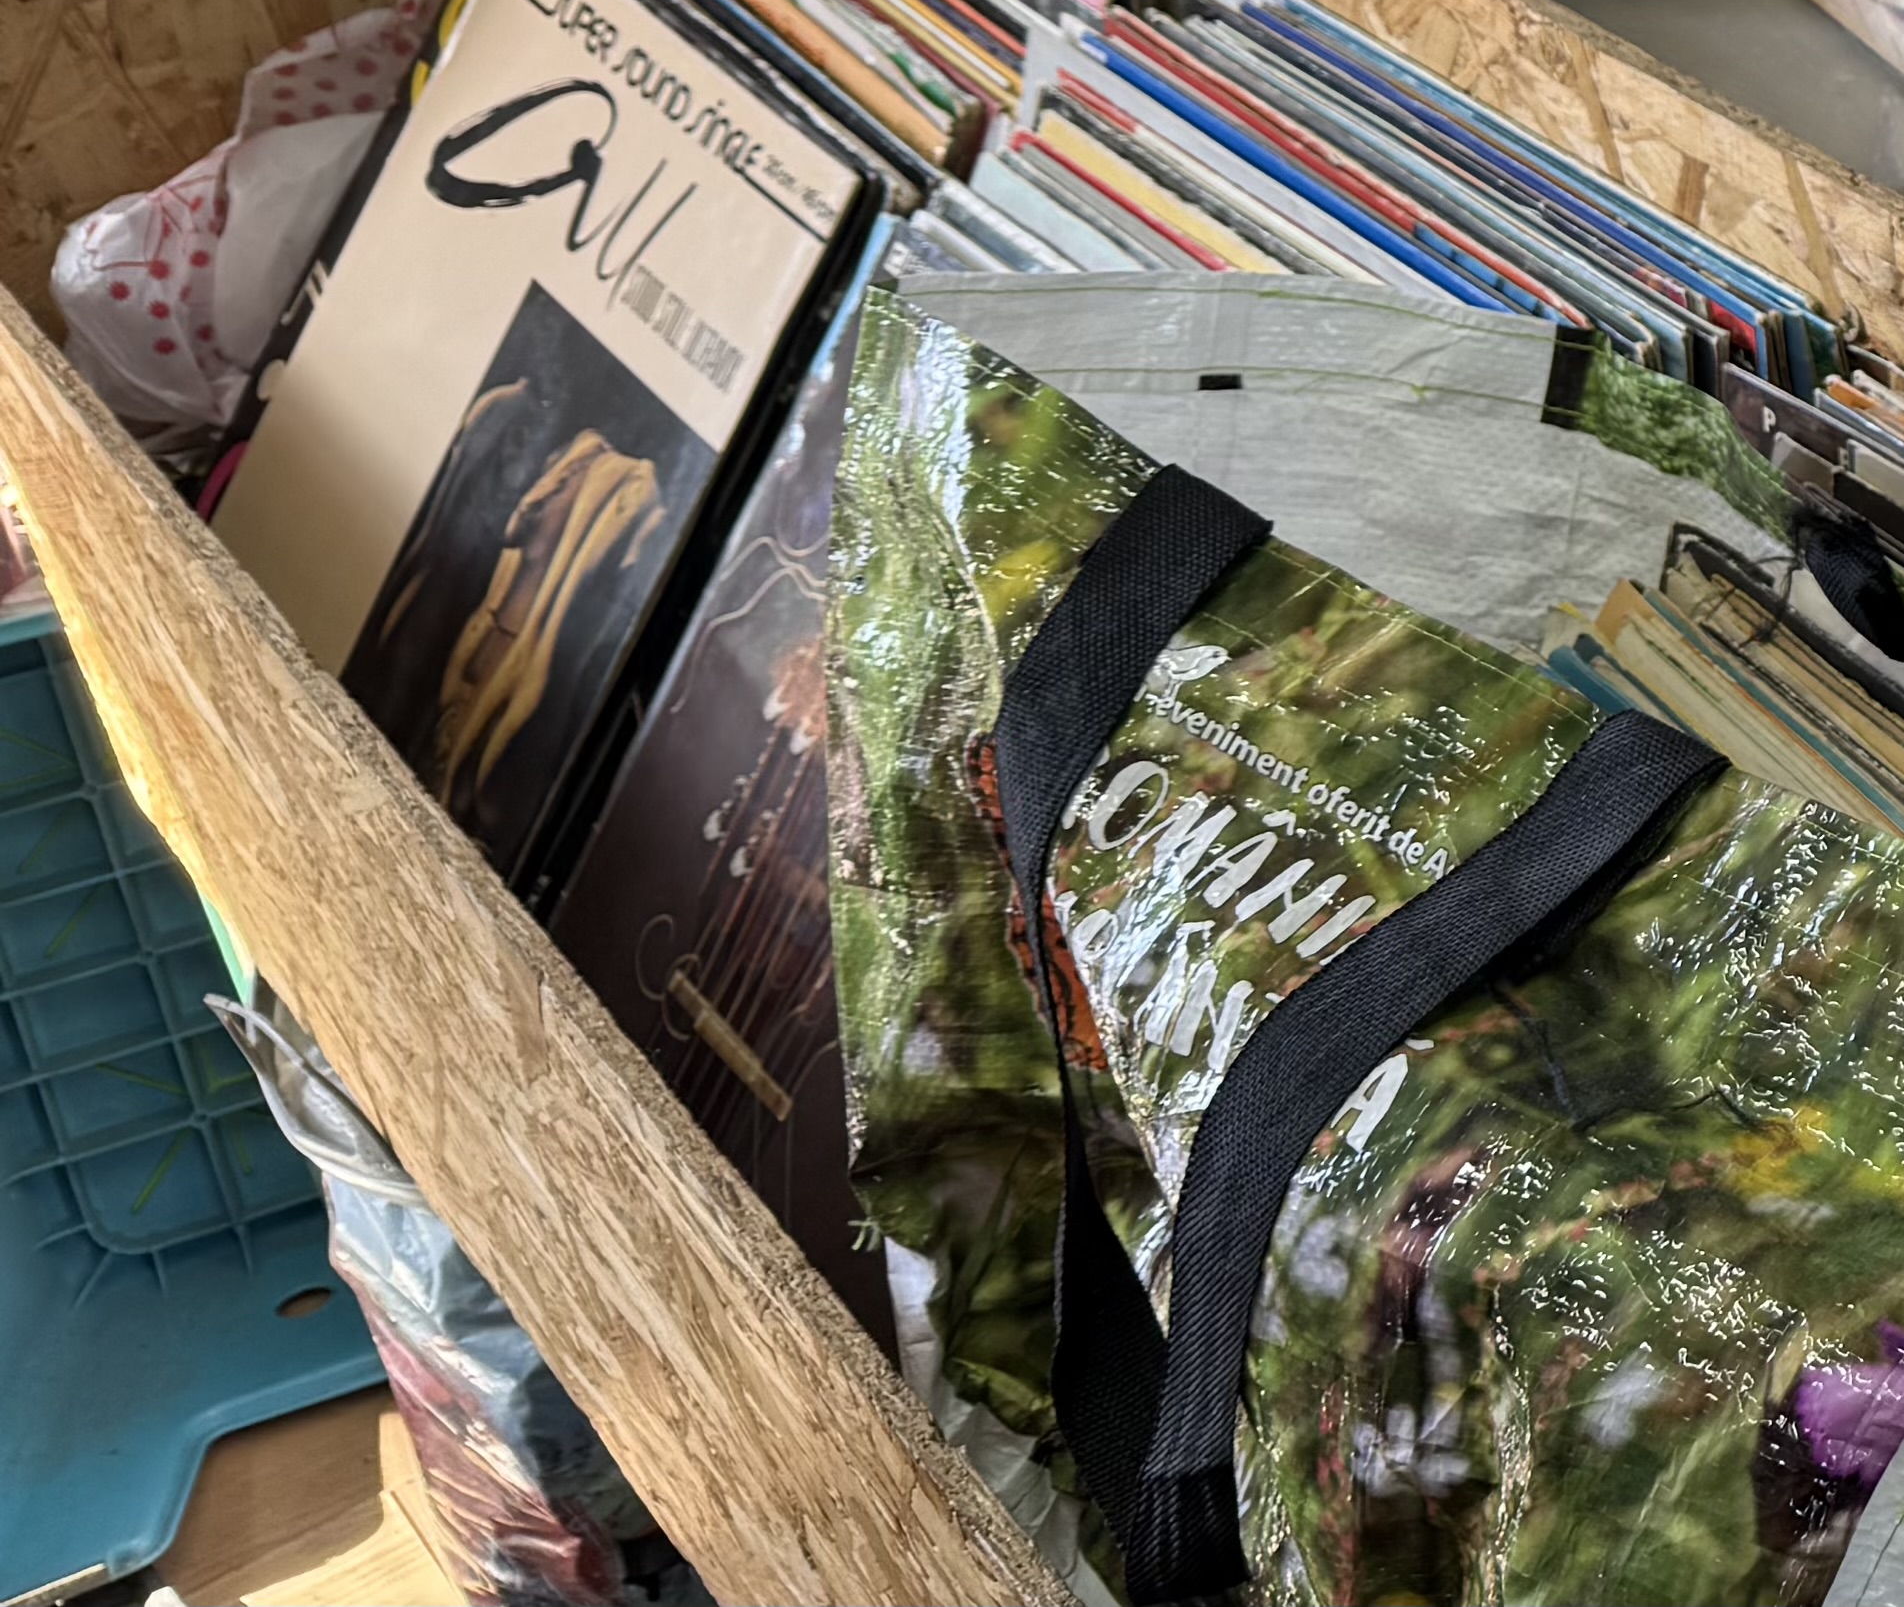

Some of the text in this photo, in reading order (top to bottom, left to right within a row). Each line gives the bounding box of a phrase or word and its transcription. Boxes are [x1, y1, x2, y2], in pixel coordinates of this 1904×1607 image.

[1307, 782, 1391, 843] oferit
[1388, 827, 1426, 866] de
[1423, 846, 1454, 882] A
